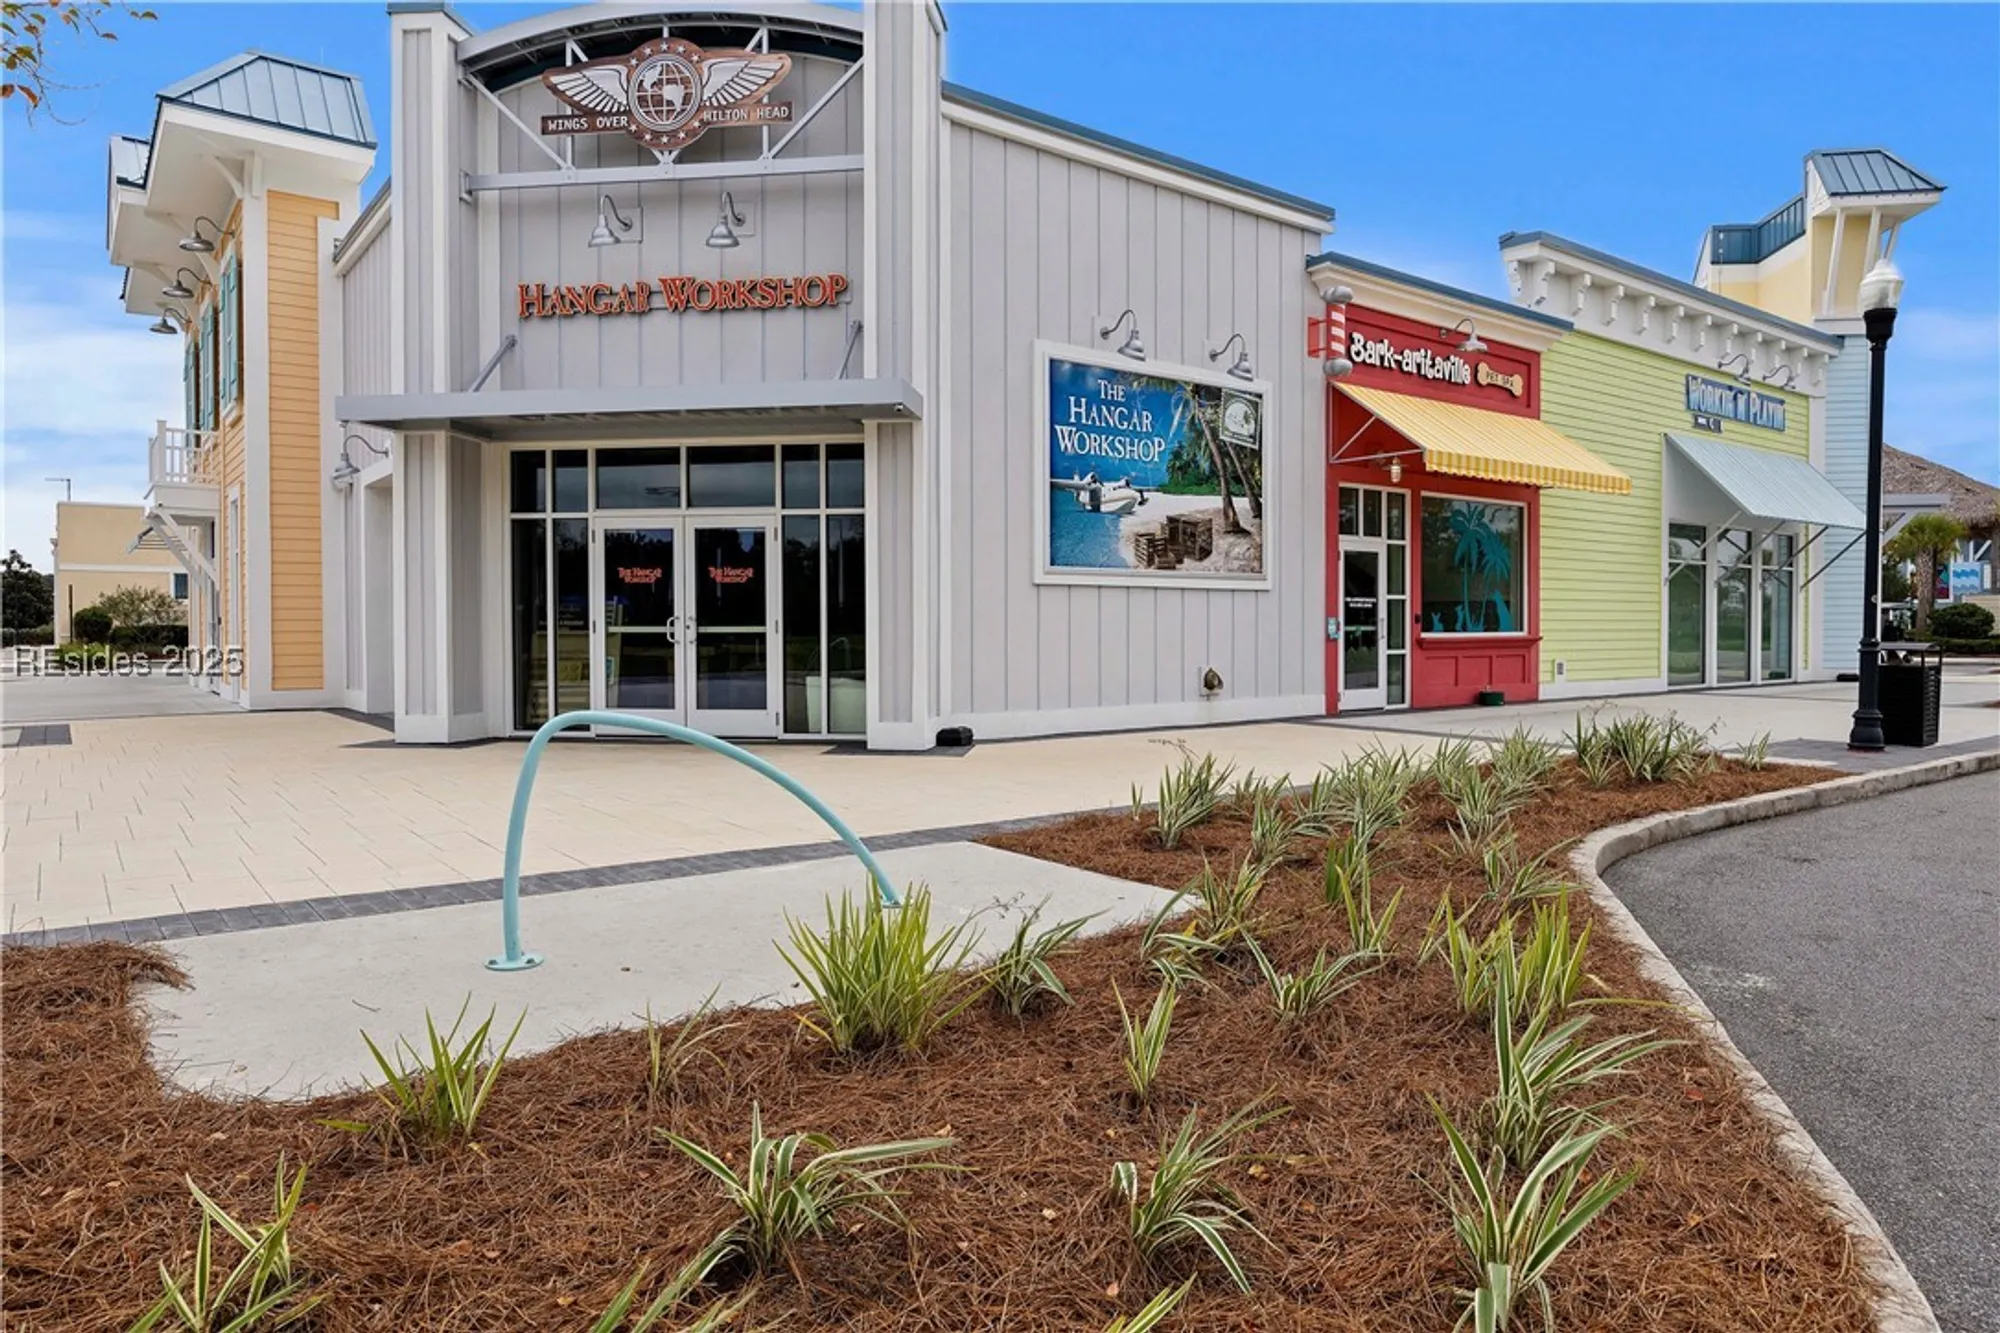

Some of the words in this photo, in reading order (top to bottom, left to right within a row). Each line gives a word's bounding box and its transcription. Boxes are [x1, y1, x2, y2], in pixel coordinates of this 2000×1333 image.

[547, 117, 589, 132] WINGS
[596, 116, 629, 129] OVER
[703, 106, 748, 122] HILTON
[757, 106, 789, 119] HEAD
[518, 281, 651, 318] HANGAR
[658, 273, 849, 313] WORKSHOP
[1098, 379, 1127, 401] THE
[1068, 396, 1153, 432] HANGAR
[1054, 425, 1166, 462] WORKSHOP
